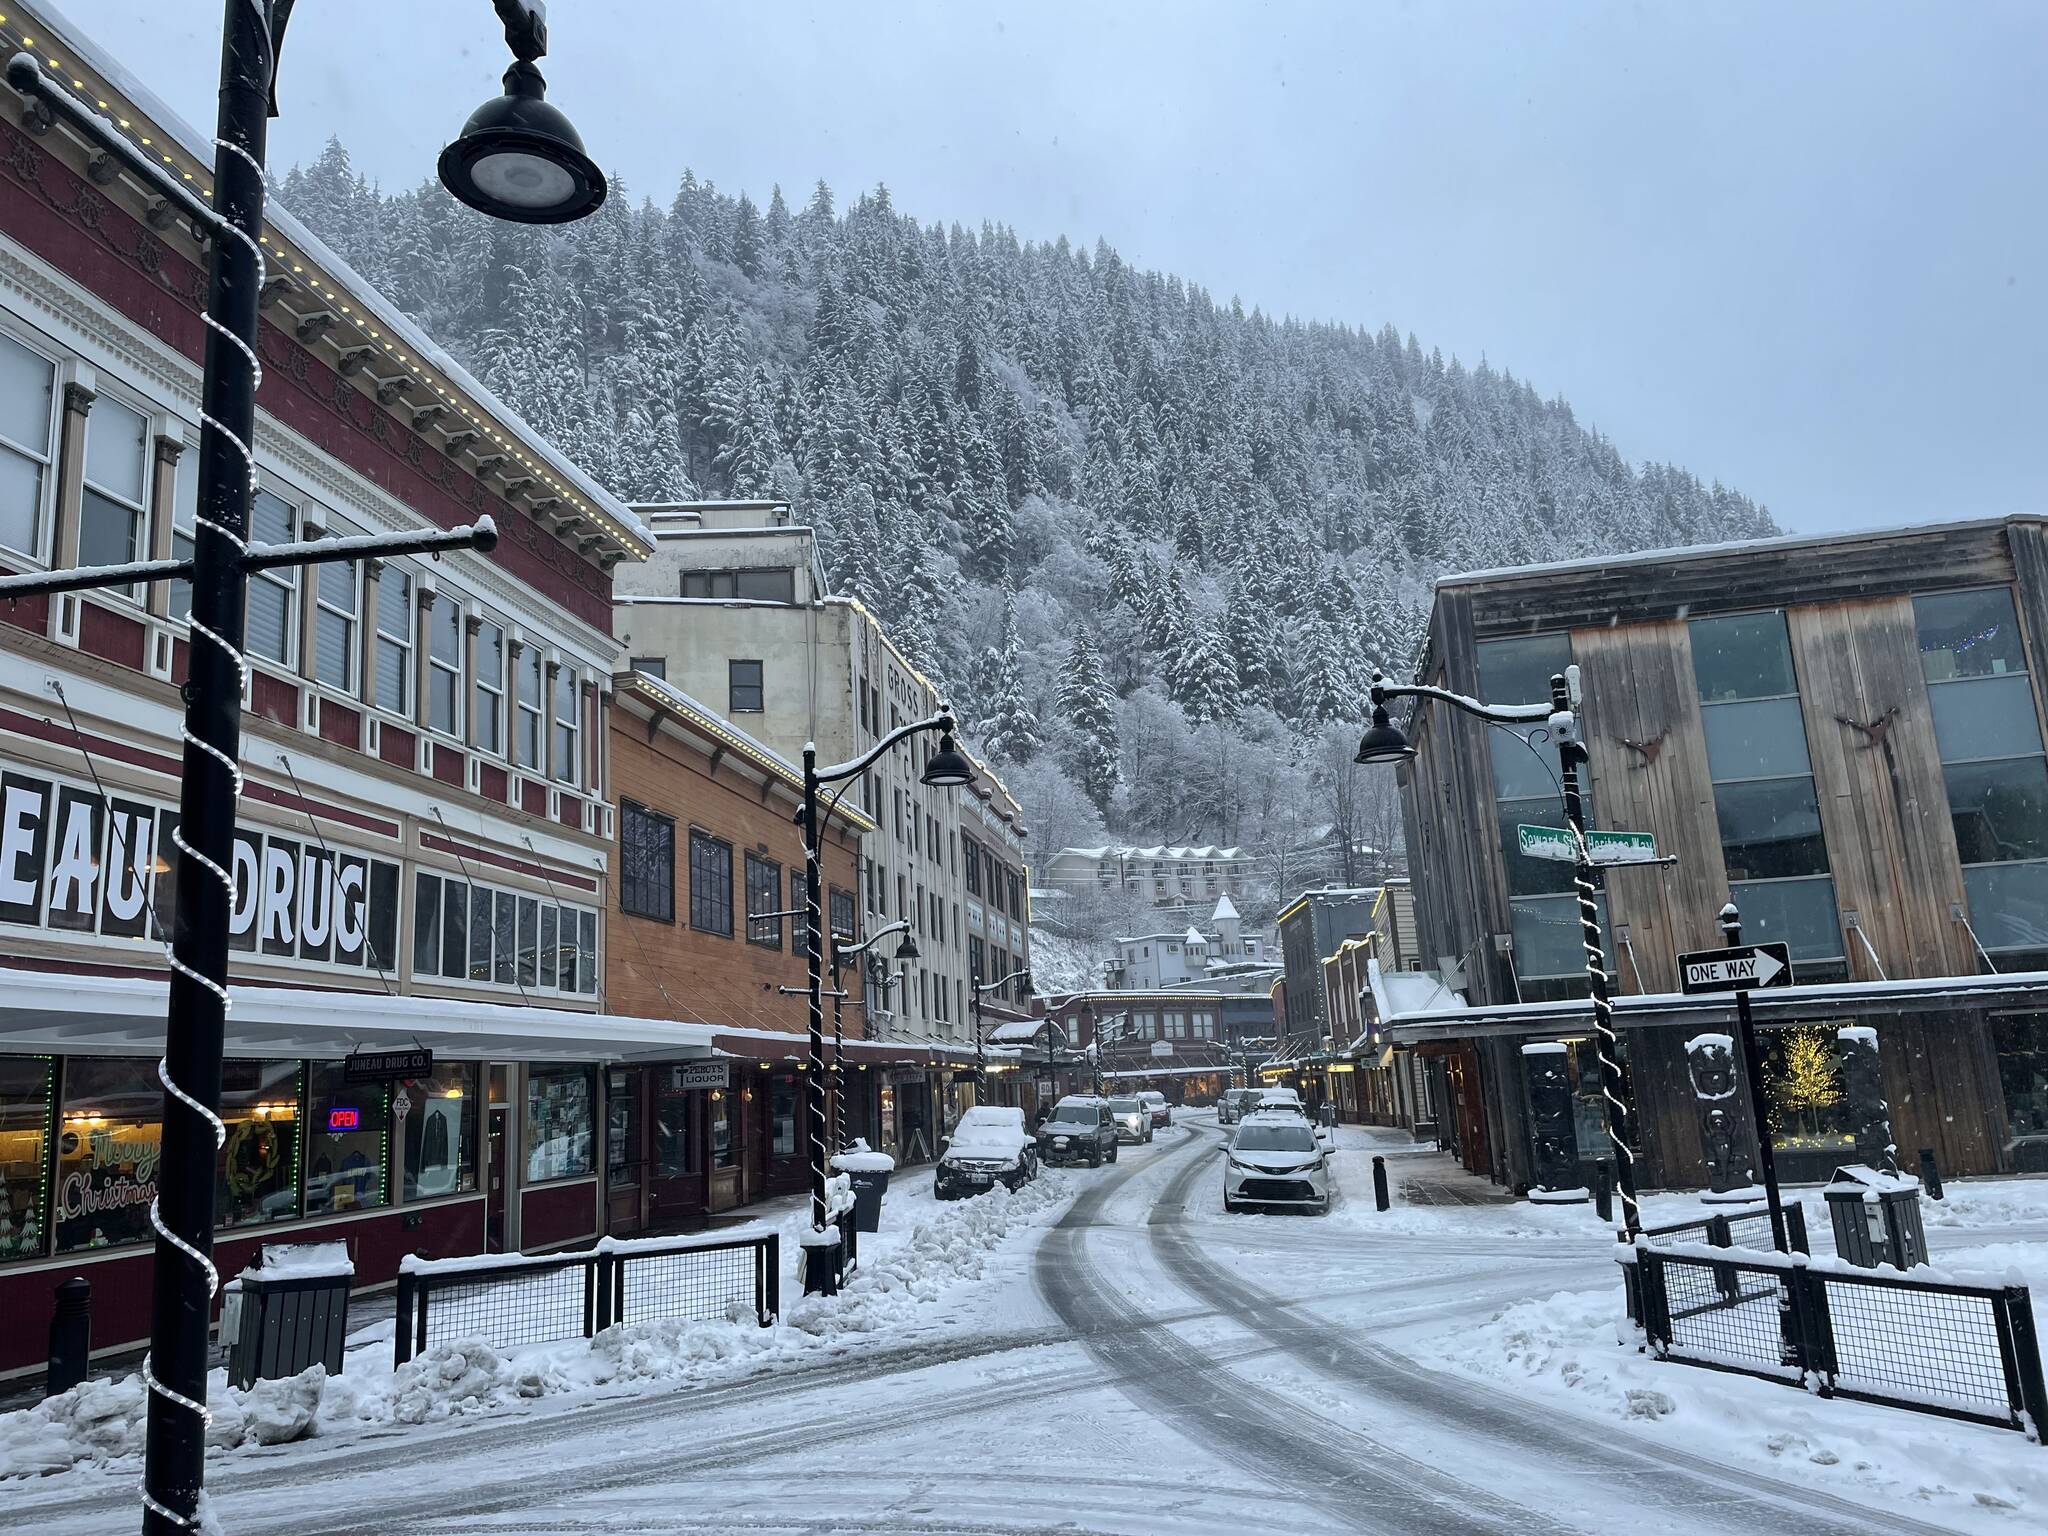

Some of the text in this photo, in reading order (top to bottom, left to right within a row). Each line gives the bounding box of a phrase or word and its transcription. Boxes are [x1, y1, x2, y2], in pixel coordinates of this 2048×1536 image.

[887, 663, 919, 717] GROSS
[1586, 835, 1630, 850] Heite
[228, 837, 367, 953] DRUG
[1690, 959, 1756, 982] ONE WAY
[349, 1055, 427, 1072] JUNEAU DRUG CO.
[686, 1075, 724, 1083] LIQUOR
[331, 1111, 358, 1127] OPEN
[62, 1171, 159, 1219] Christmas
